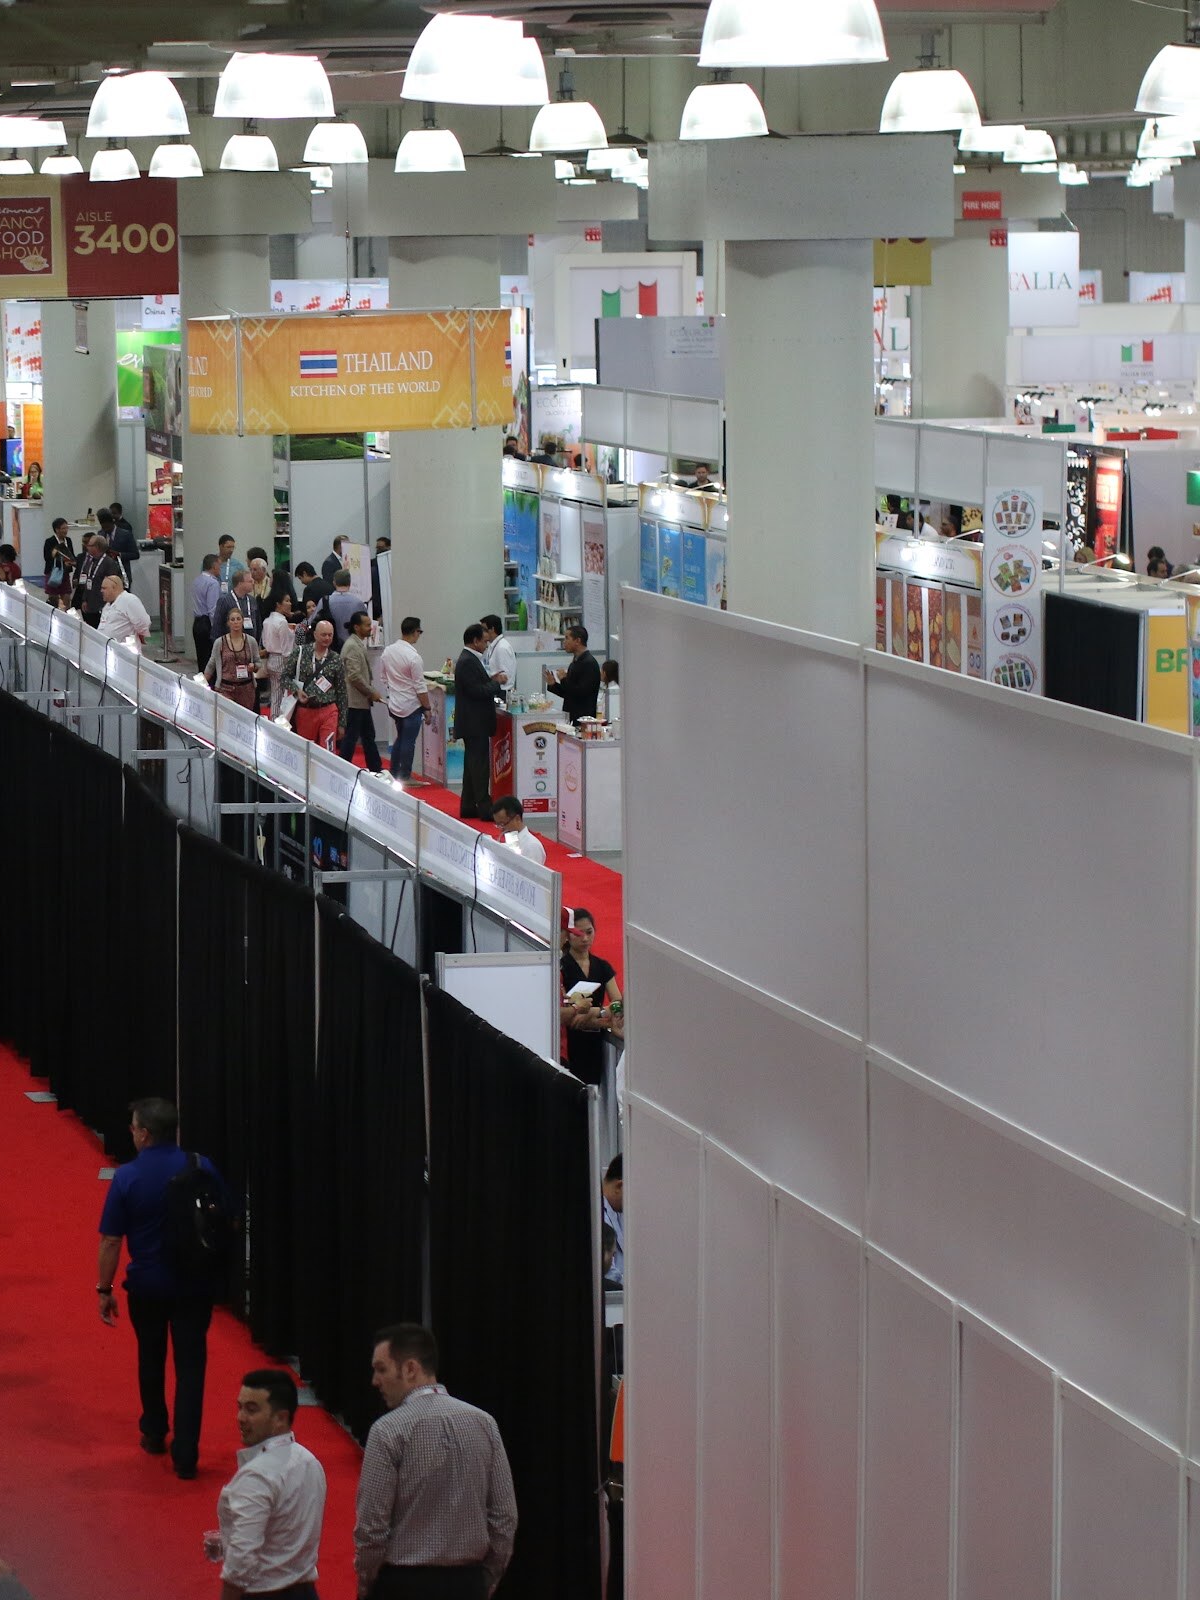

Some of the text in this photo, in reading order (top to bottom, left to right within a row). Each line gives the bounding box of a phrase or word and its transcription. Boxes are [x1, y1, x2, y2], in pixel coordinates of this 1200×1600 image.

[963, 201, 1000, 210] FIRE HOSE
[76, 211, 113, 222] AISLE
[73, 222, 176, 256] 3400
[342, 350, 434, 374] THAILAND
[289, 380, 441, 398] KITCHEN OF THE WORLD
